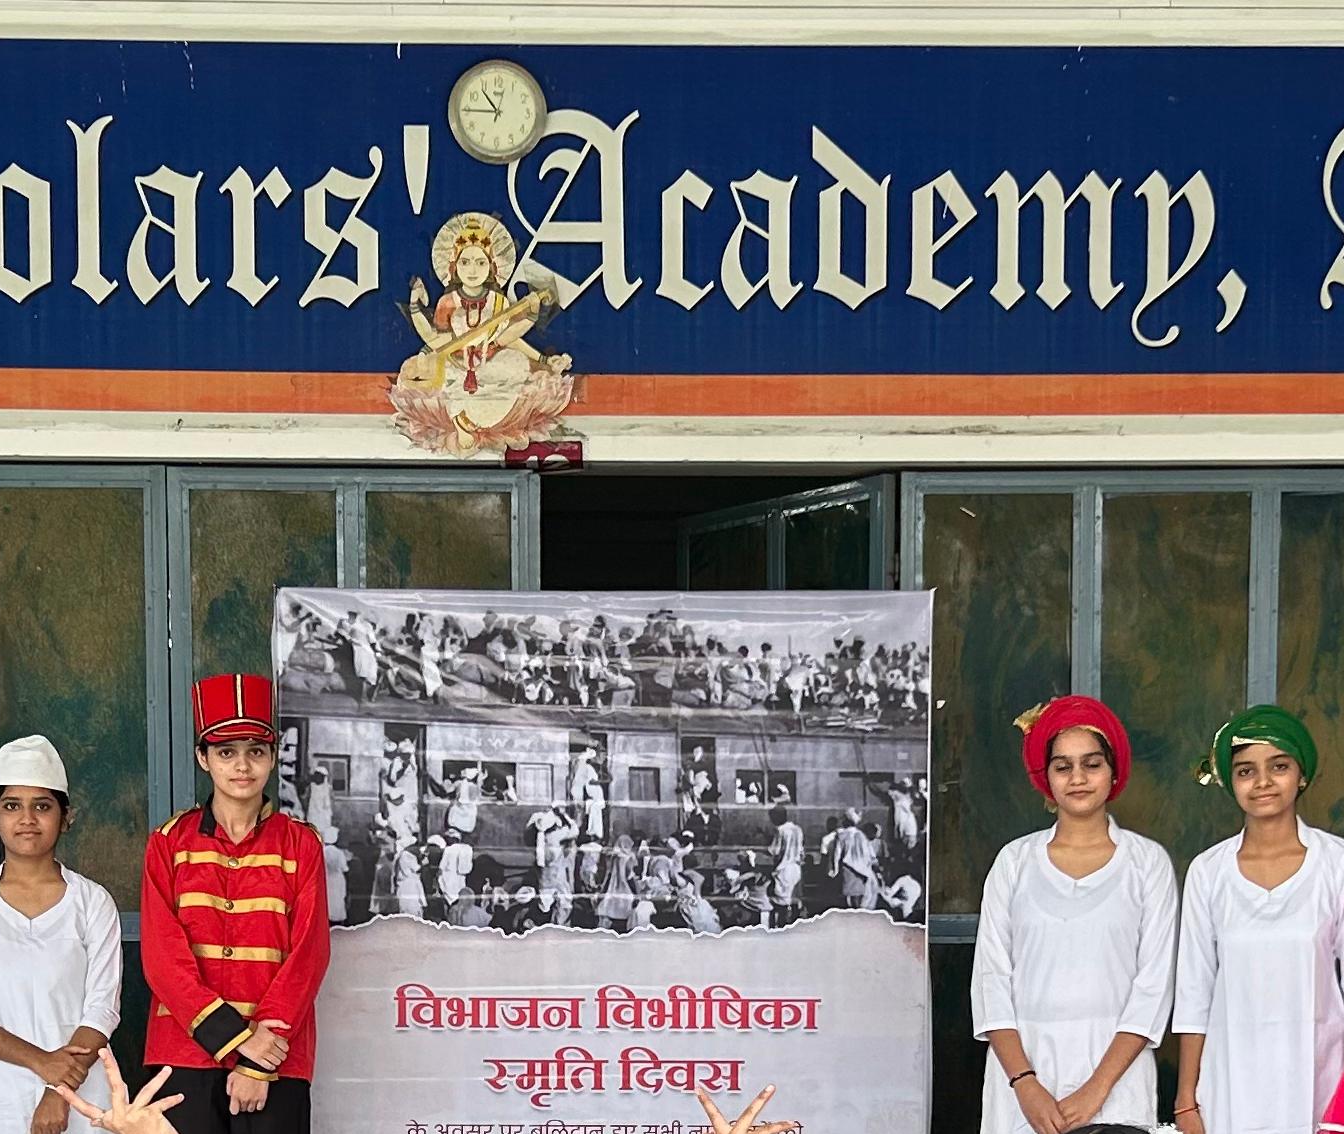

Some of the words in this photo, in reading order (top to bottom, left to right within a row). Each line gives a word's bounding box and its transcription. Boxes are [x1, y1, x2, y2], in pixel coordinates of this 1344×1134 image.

[506, 109, 1247, 347] Academy,
[394, 983, 585, 1029] विभाजन
[595, 984, 821, 1030] विभीषिका
[483, 1046, 608, 1108] स्मृति
[618, 1046, 745, 1094] दिवस
